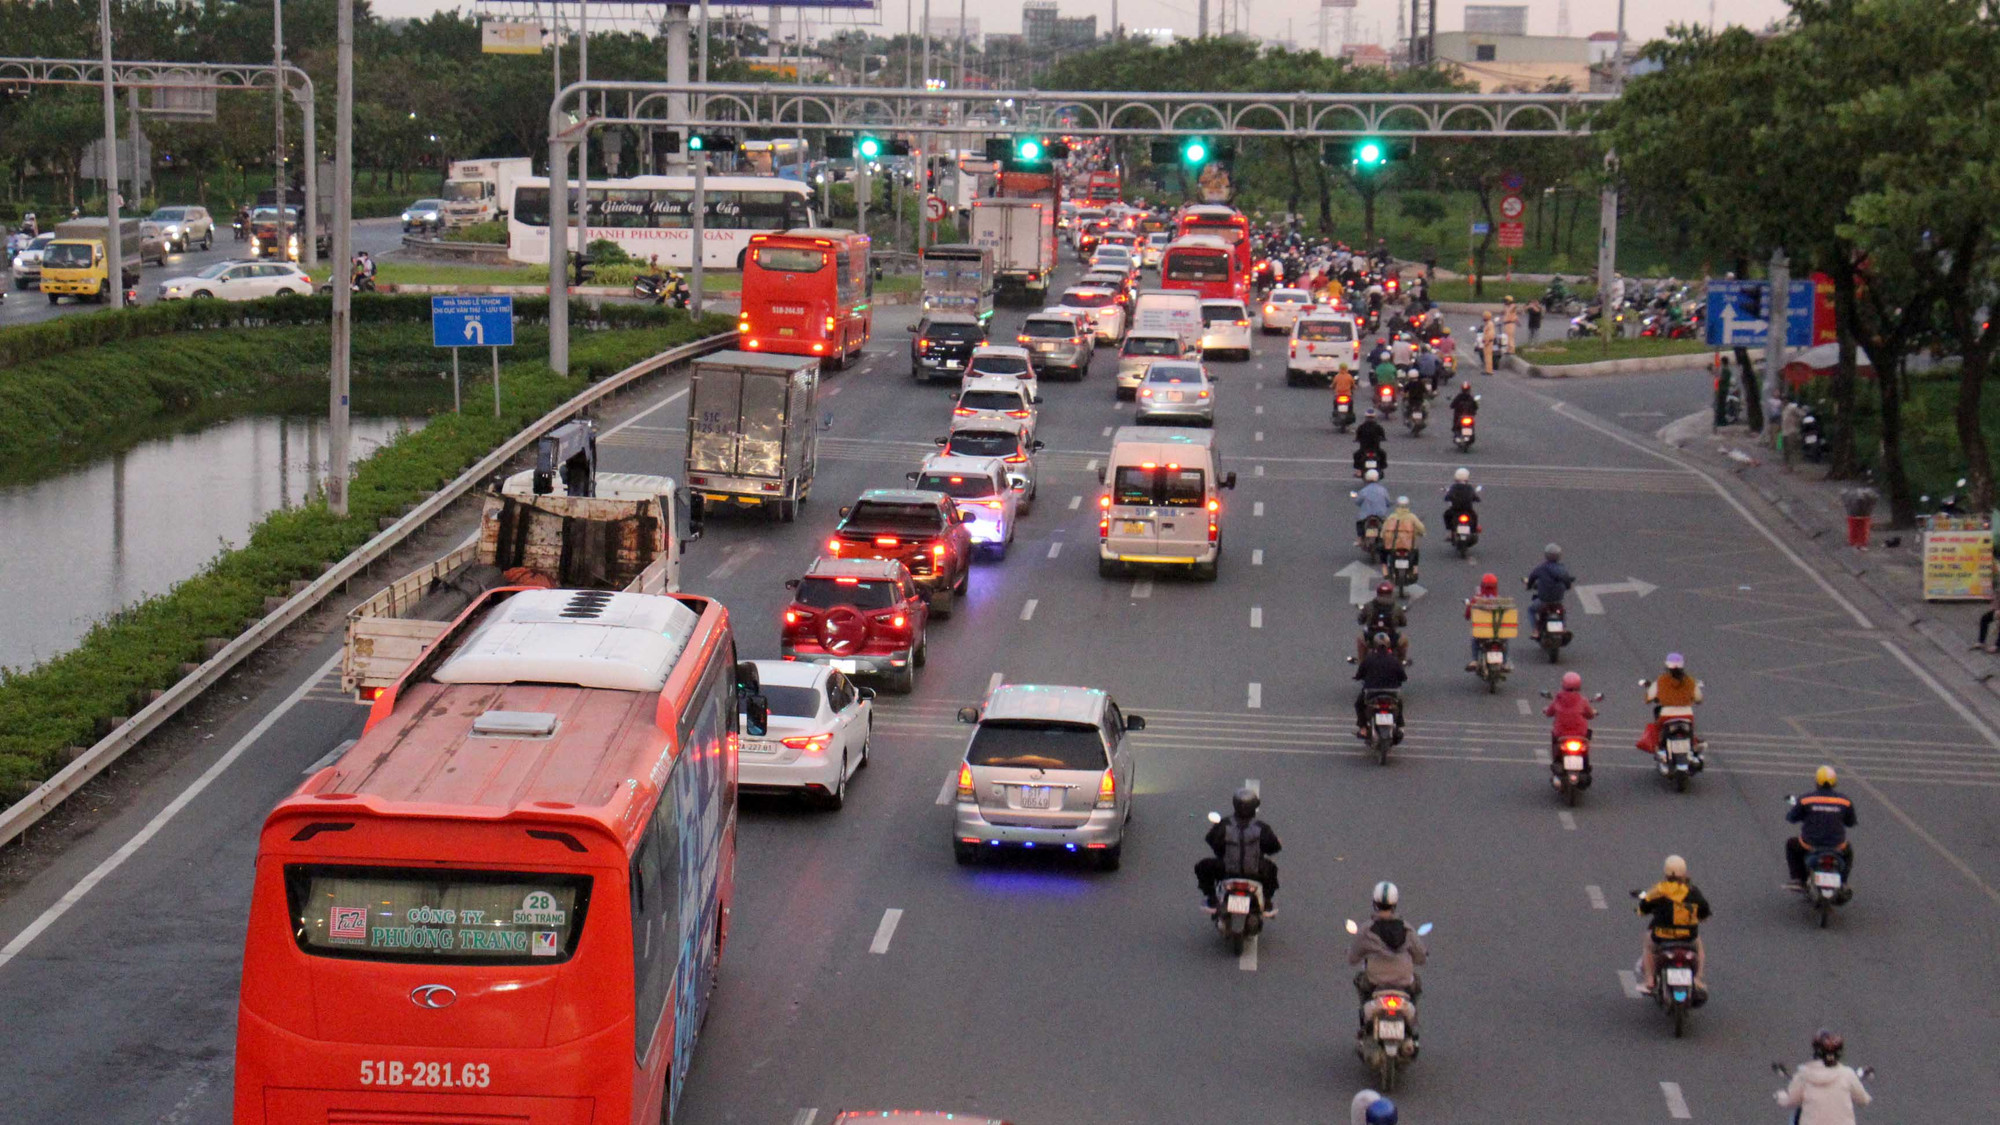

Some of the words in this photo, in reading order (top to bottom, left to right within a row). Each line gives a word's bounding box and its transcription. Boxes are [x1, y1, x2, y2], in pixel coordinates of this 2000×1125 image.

[600, 200, 644, 215] Giường
[687, 201, 710, 214] Co
[576, 229, 625, 239] HANH
[529, 895, 550, 909] 28
[408, 906, 456, 924] CÔNG
[461, 910, 485, 924] TY
[371, 925, 454, 949] PHƯƠNG
[459, 929, 527, 951] TRANG
[359, 1060, 491, 1088] 51B-281.63
